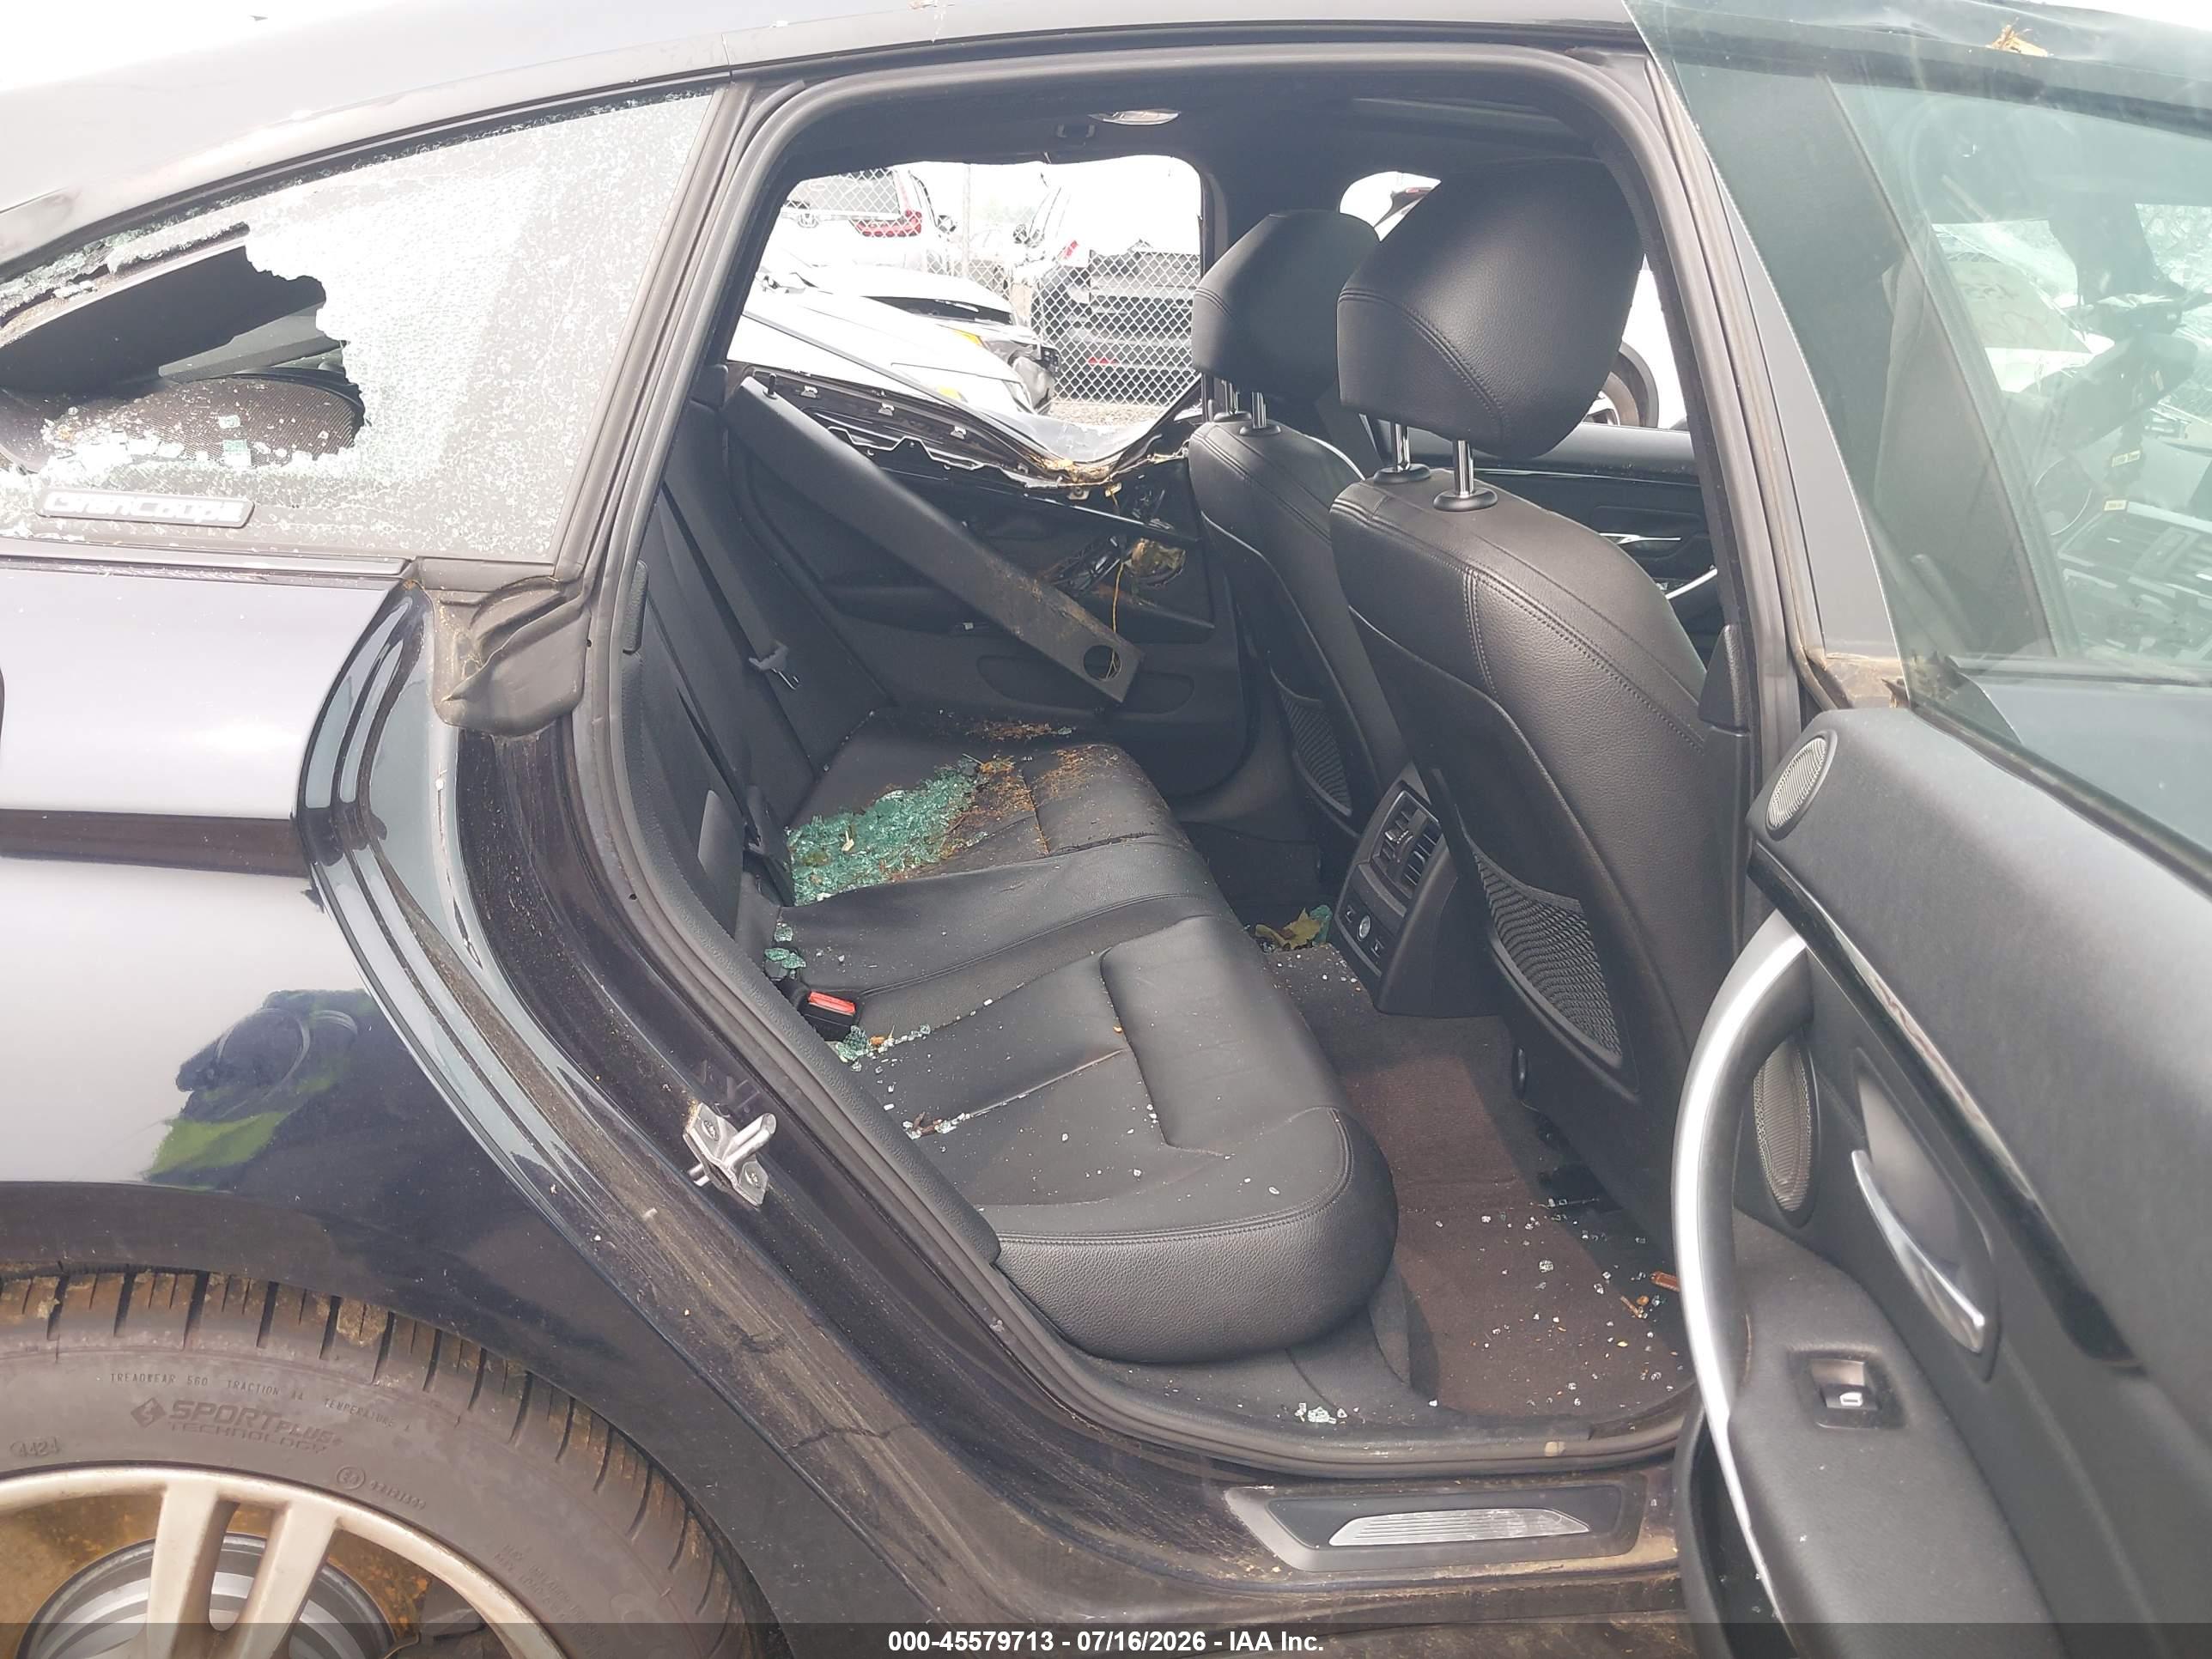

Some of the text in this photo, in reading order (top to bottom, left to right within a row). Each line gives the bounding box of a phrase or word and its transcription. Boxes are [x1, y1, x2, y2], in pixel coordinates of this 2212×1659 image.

[111, 1374, 176, 1384] TREADWEAR
[187, 1376, 208, 1386] 560
[228, 1381, 279, 1395] TRACTION
[325, 1399, 394, 1427] TEMPERATURE
[168, 1421, 328, 1454] TECHNOLOGY
